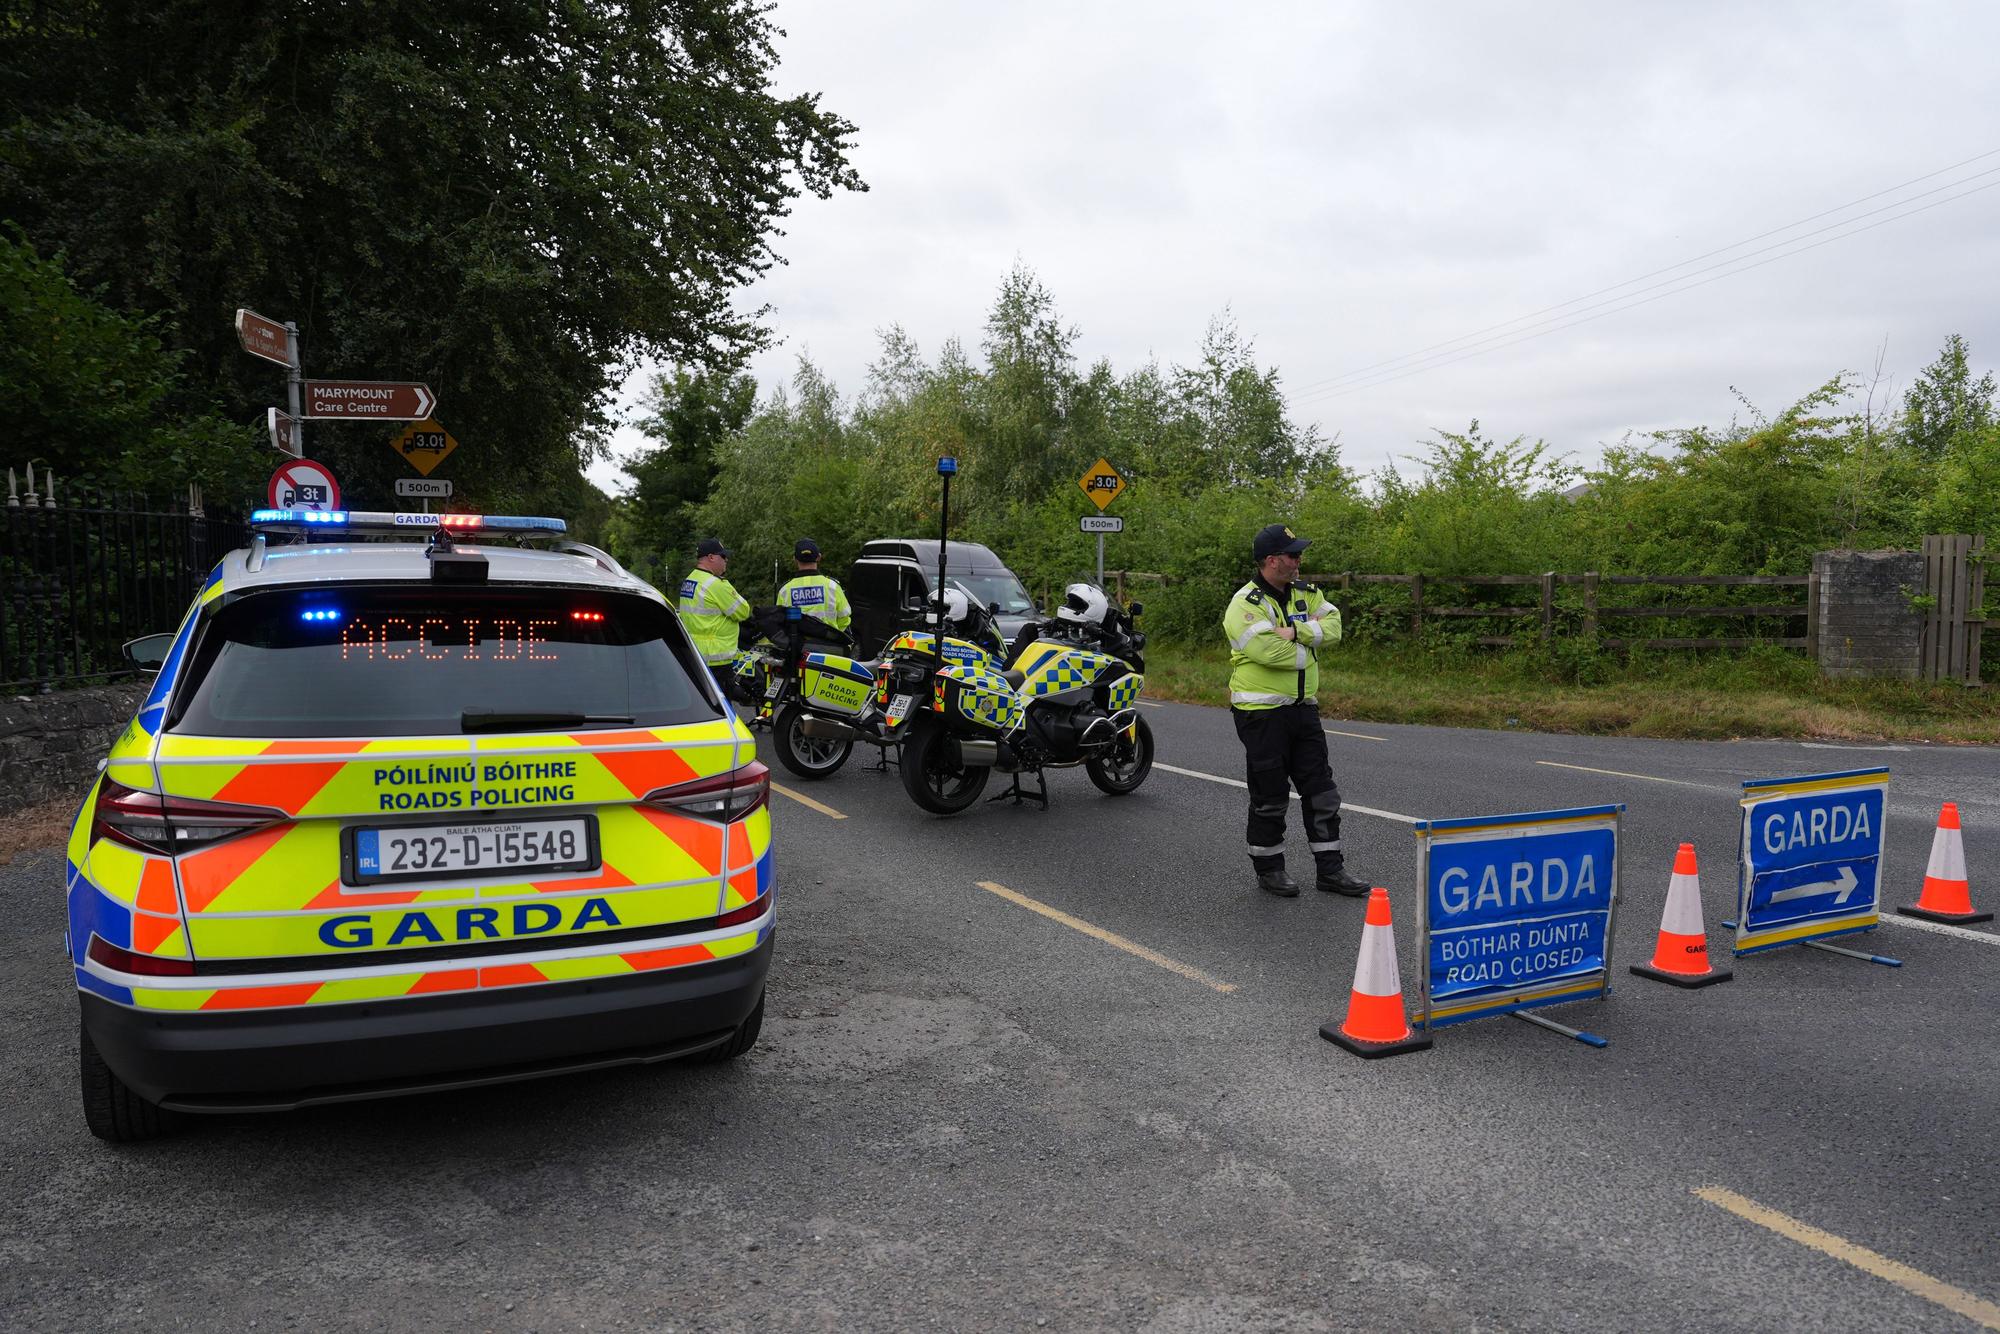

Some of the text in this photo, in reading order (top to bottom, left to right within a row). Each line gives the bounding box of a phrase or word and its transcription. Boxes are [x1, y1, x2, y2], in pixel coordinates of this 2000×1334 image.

[313, 387, 395, 400] MARYMOUNT
[314, 401, 388, 413] Care Centre
[416, 434, 445, 448] 3.0t
[408, 483, 440, 493] 500m
[1096, 476, 1117, 488] 3.0t
[302, 487, 319, 501] 3t
[396, 515, 439, 524] GARDA
[1090, 520, 1114, 528] 500m
[792, 587, 823, 601] GARDA
[343, 618, 558, 660] ACCIDE
[828, 682, 857, 697] ROADS
[819, 689, 859, 706] POLICING
[374, 761, 577, 786] PÓILÍNIÚ BÓITHRE
[379, 784, 575, 810] ROADS POLICING
[471, 826, 493, 834] ÁTHA
[1763, 802, 1871, 855] GARDA
[390, 829, 576, 871] 232-D-15548
[359, 858, 379, 869] IRL
[1438, 854, 1596, 915] GARDA
[318, 897, 622, 949] GARDA
[1441, 921, 1590, 962] BÓTHAR DÚNTA
[1446, 946, 1584, 984] ROAD CLOSED
